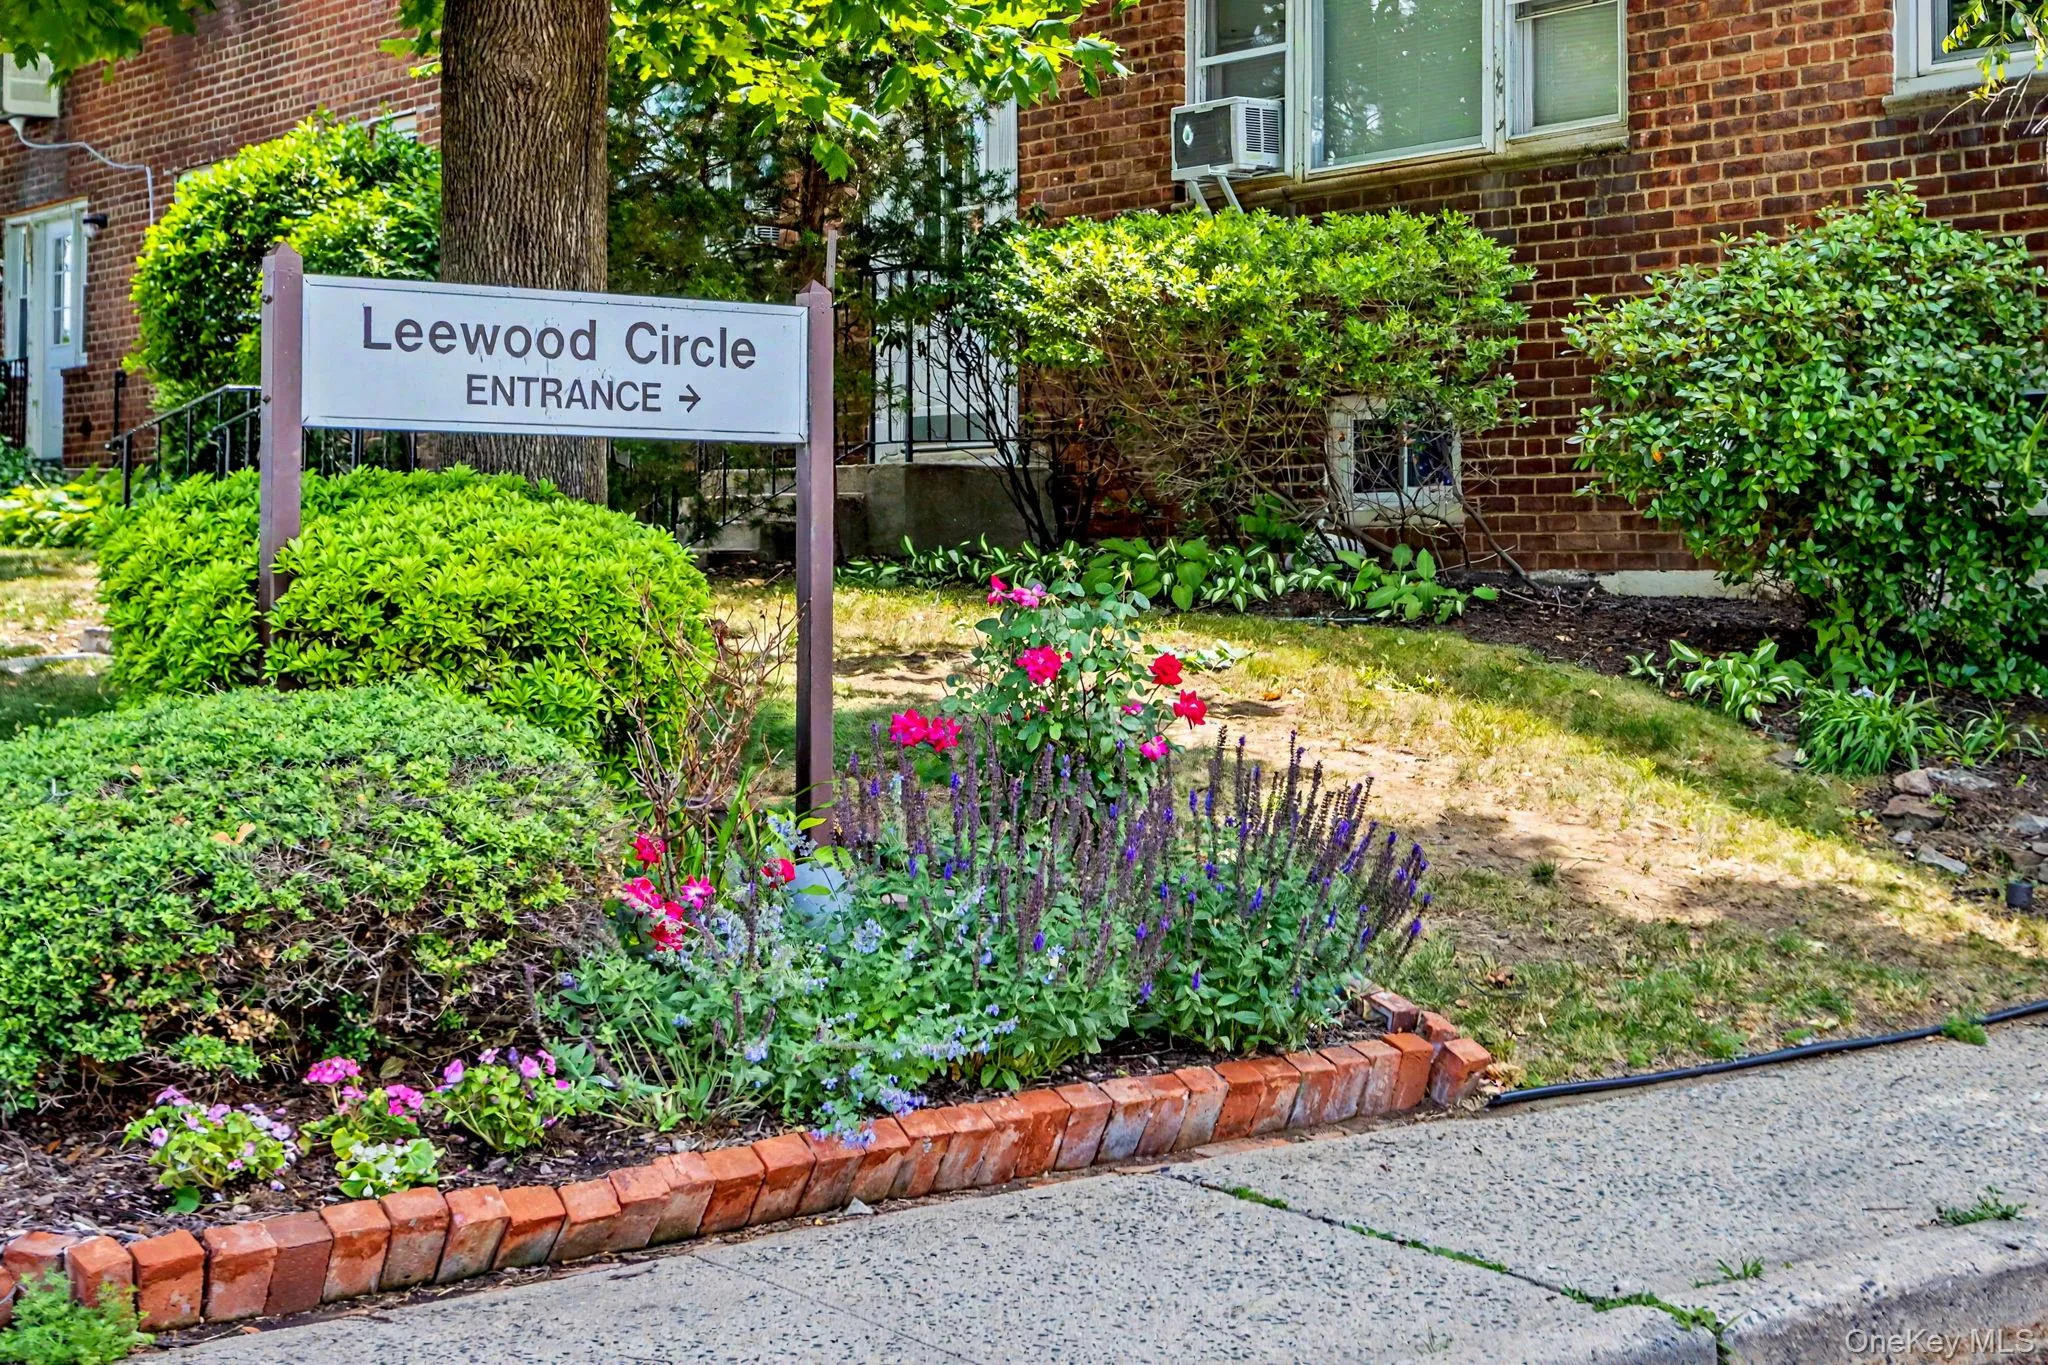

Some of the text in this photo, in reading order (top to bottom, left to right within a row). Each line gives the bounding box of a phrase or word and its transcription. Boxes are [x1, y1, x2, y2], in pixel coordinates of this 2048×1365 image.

[362, 305, 756, 369] Leewood Circle
[466, 374, 662, 412] ENTRANCE
